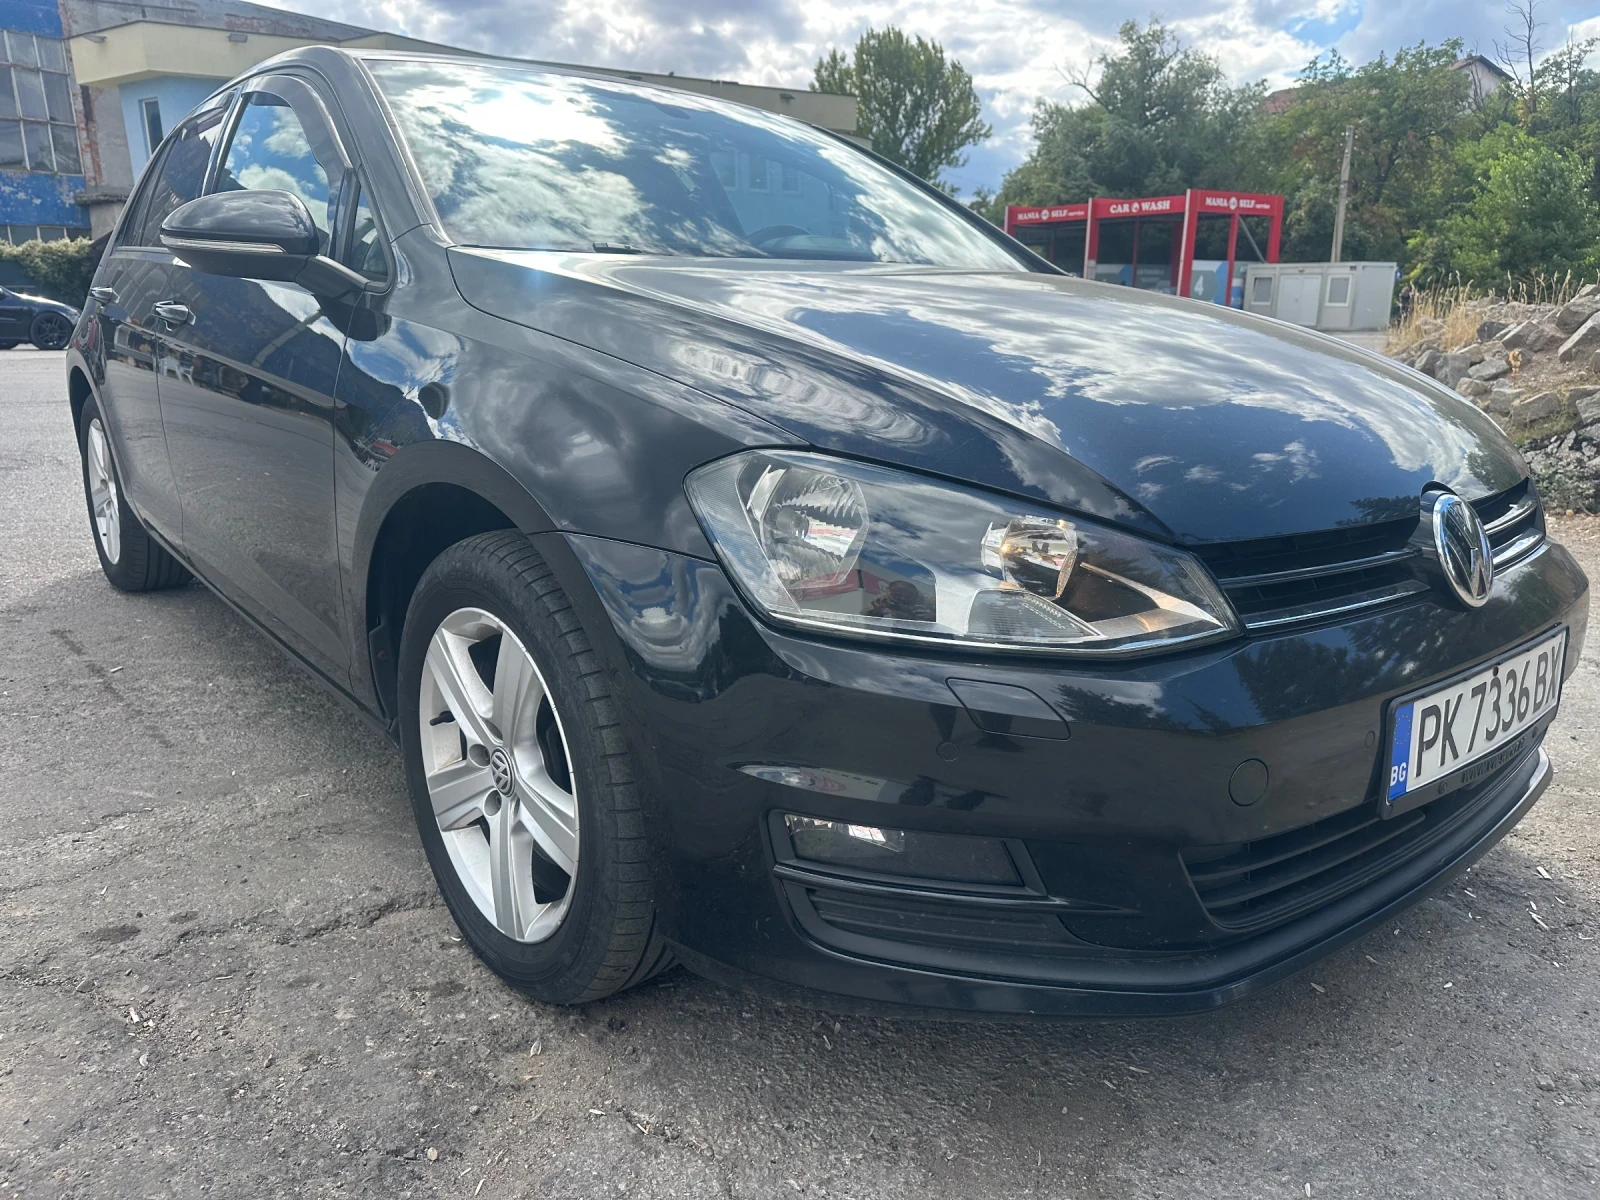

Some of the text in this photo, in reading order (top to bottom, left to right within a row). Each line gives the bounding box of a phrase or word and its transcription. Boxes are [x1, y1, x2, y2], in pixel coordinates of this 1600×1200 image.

[1109, 200, 1171, 214] CAR WASH
[1193, 275, 1204, 296] 4
[1414, 692, 1464, 779] PK
[1466, 660, 1531, 754] 7336
[1532, 641, 1562, 715] BX
[1389, 761, 1408, 787] BG
